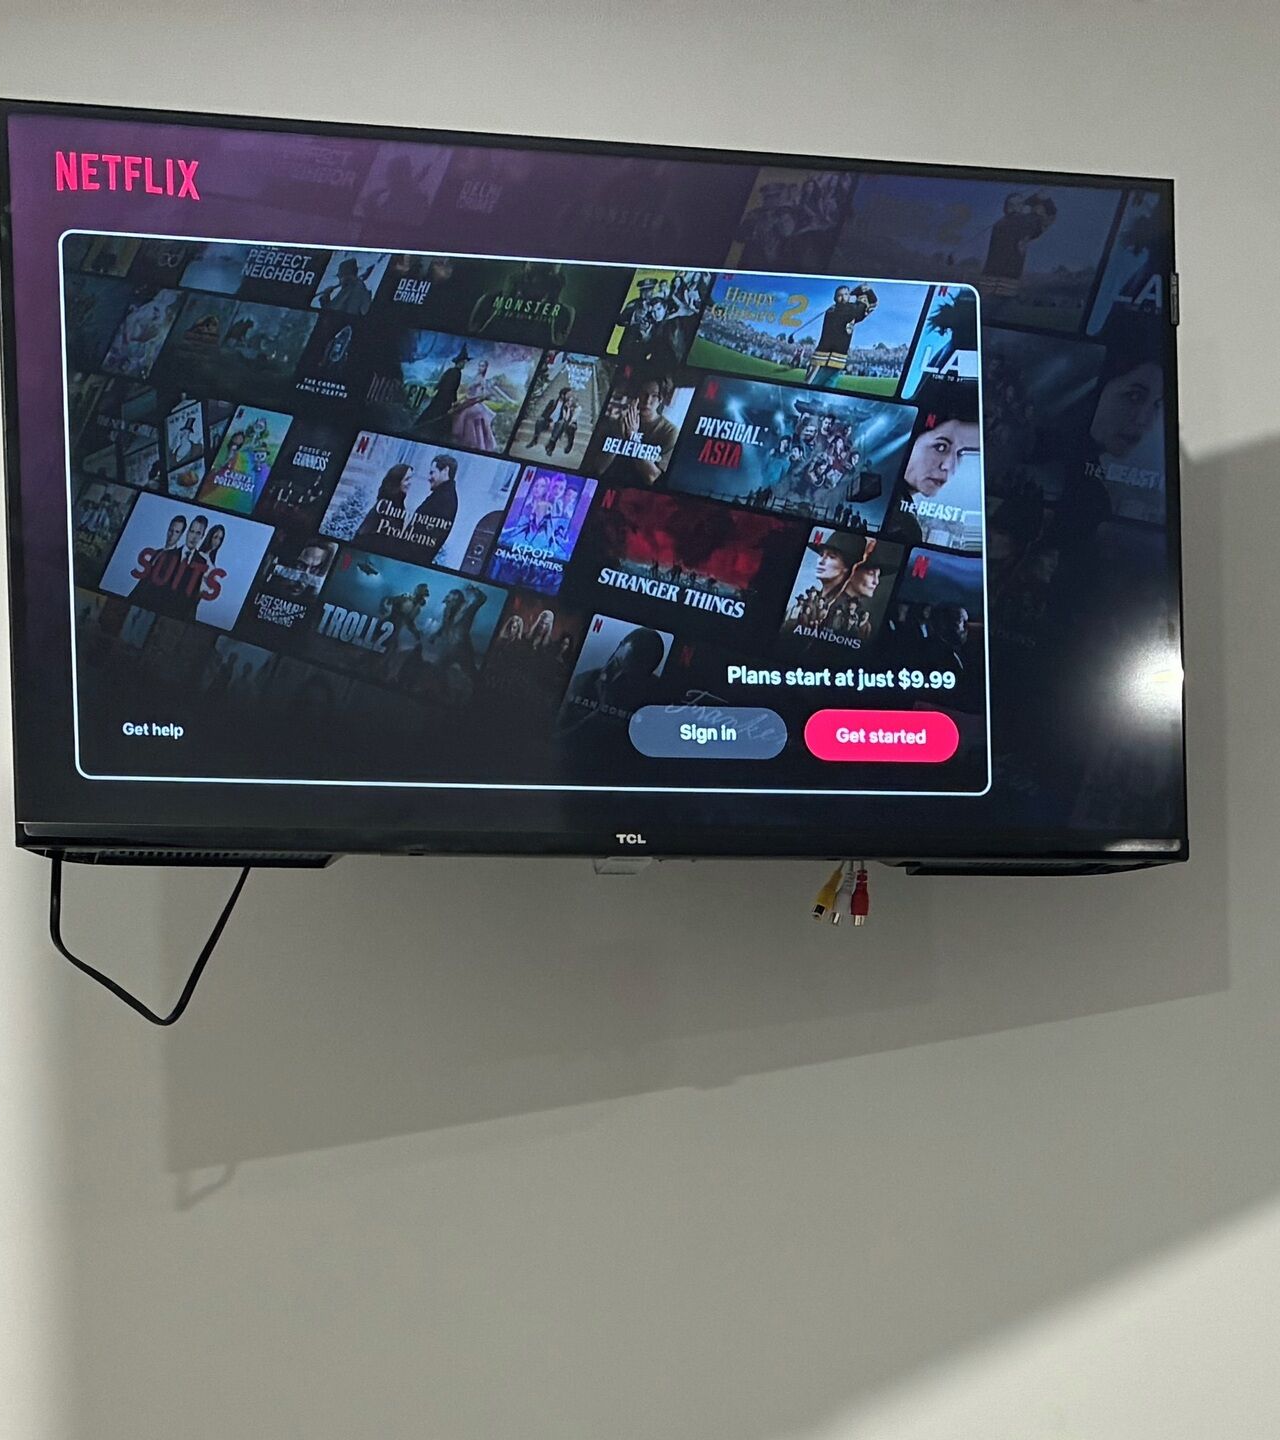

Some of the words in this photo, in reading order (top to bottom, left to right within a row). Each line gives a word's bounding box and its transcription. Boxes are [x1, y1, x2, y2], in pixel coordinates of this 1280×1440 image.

[55, 151, 200, 200] NETFLIX
[247, 248, 312, 267] PERFECT
[241, 263, 315, 285] NEIGHBOR
[397, 278, 432, 293] DELHI
[393, 290, 427, 305] CRIME
[493, 296, 561, 316] MONSTER
[780, 294, 809, 327] 2
[629, 431, 644, 444] THE
[698, 439, 743, 469] ASIA
[376, 498, 453, 531] Champagne
[376, 518, 437, 548] Problems
[131, 547, 227, 601] SUITS
[597, 567, 680, 602] STRANGER
[683, 588, 746, 619] THINGS
[318, 602, 380, 651] TROLL
[375, 621, 395, 653] 2
[793, 624, 862, 649] ABANDONS
[727, 666, 781, 686] Plans
[785, 668, 831, 687] start
[835, 668, 854, 687] at
[857, 669, 894, 691] just
[898, 668, 956, 690] $9.99
[122, 722, 149, 736] Get
[152, 723, 184, 740] help
[680, 724, 718, 744] Sign
[721, 725, 737, 741] in
[836, 728, 865, 743] Get
[869, 728, 926, 745] started
[616, 834, 646, 844] TCL
